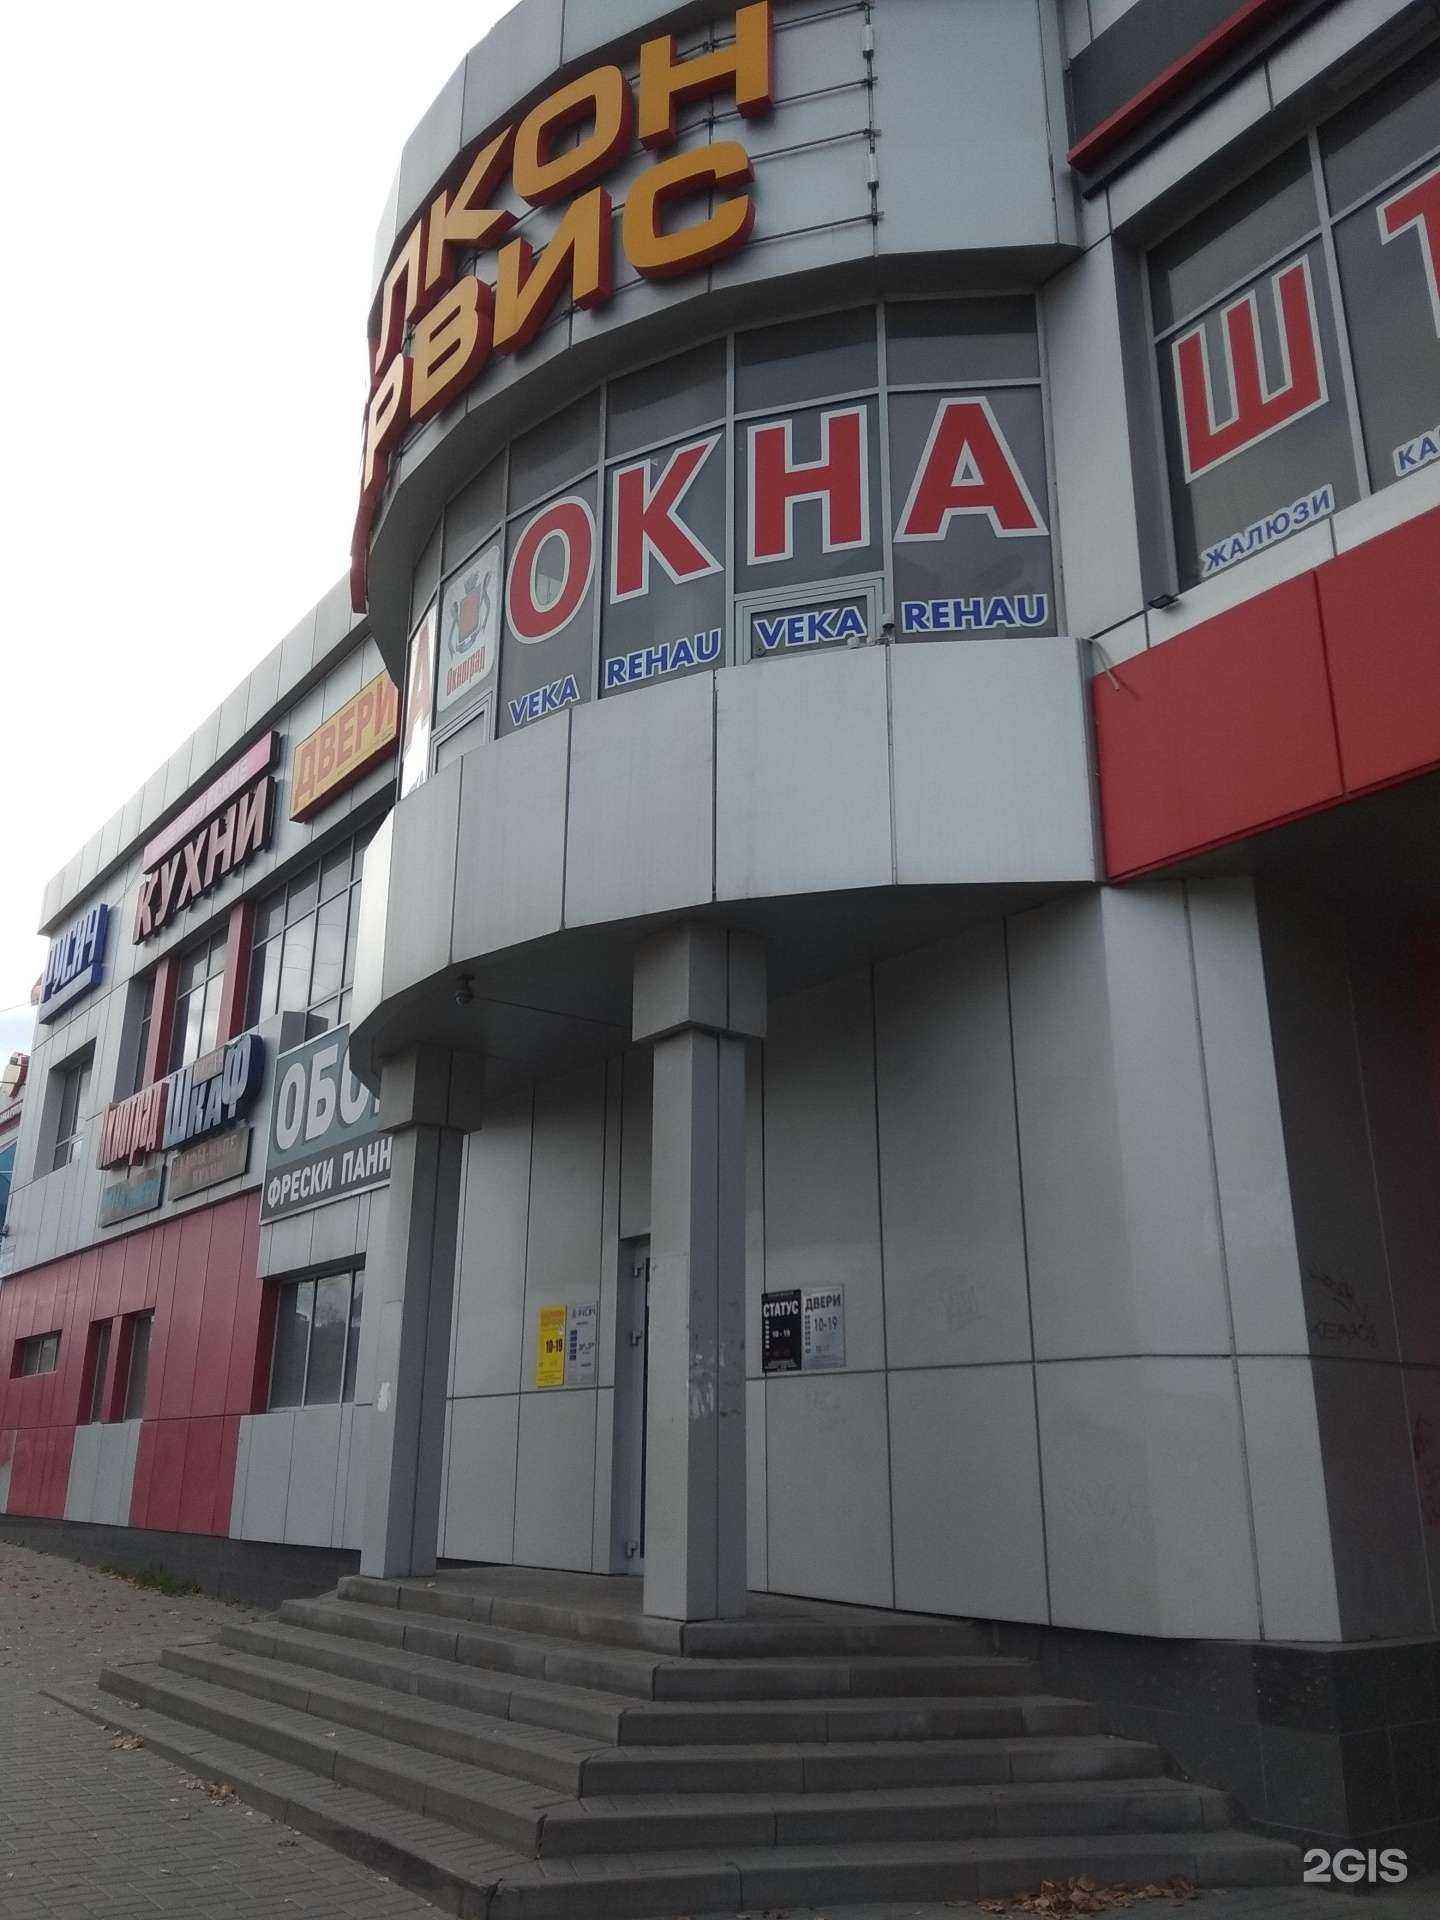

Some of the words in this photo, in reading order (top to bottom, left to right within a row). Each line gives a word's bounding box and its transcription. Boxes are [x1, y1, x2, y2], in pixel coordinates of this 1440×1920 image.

[505, 395, 1050, 646] ОКНА
[1202, 484, 1334, 577] ЖАЛЮЗИ
[753, 605, 867, 650] VEKA
[900, 593, 1048, 634] REHAU
[604, 628, 722, 690] REHAU
[508, 673, 580, 727] VEKA
[293, 676, 398, 812] ДВЕРИ
[132, 775, 275, 946] КУХНИ
[266, 1156, 335, 1209] ФРЕСКИ
[340, 1136, 393, 1185] ПАНН
[763, 1300, 799, 1318] СТАТУС
[804, 1294, 841, 1313] ДВЕРИ
